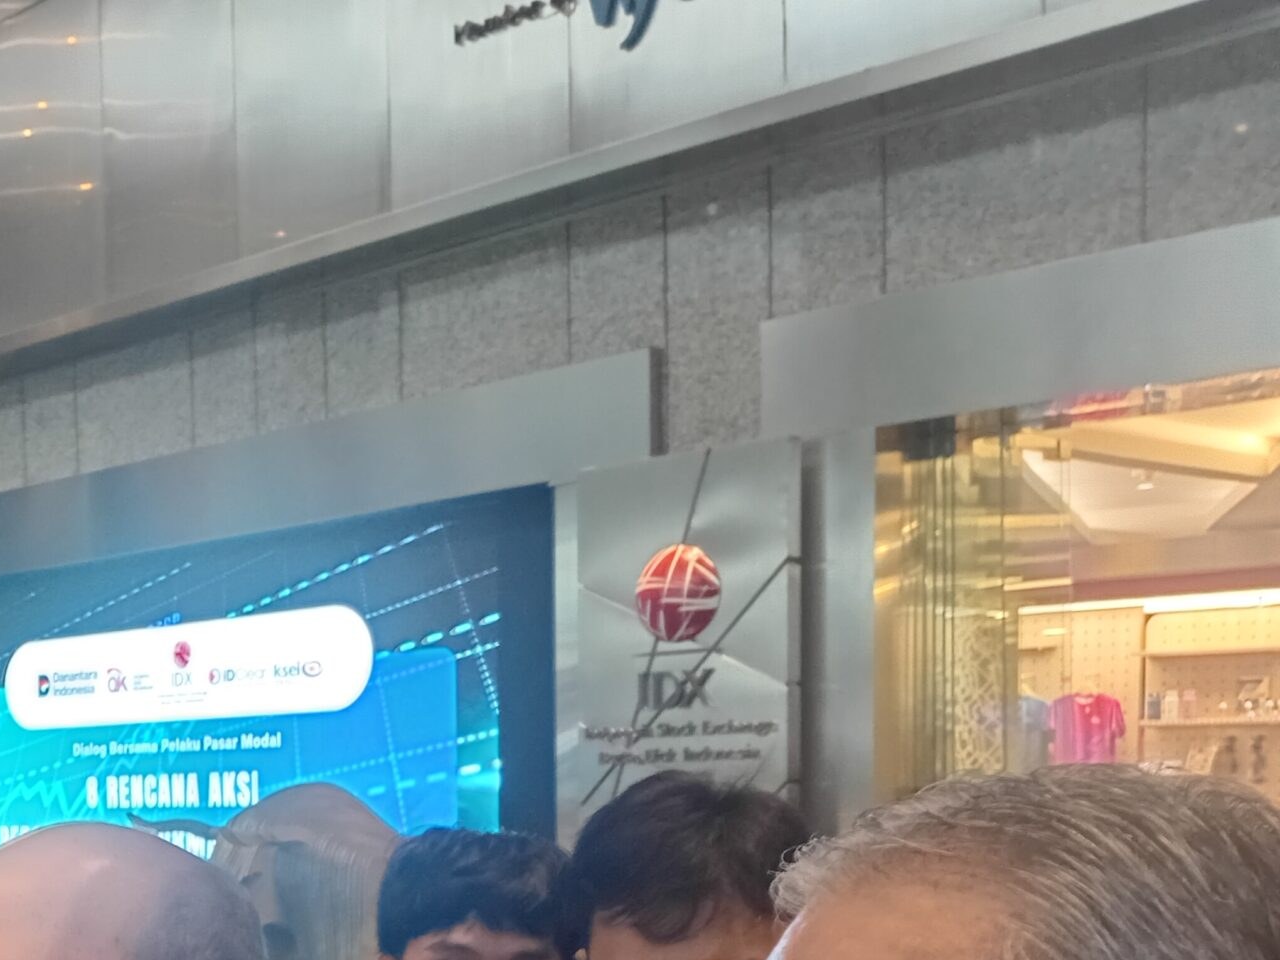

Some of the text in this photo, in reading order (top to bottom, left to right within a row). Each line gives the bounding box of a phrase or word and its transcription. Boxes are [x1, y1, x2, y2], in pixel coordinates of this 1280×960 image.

[53, 671, 98, 683] Danantara
[171, 671, 192, 687] IDX
[53, 685, 96, 697] Indonesia
[637, 668, 716, 709] IDX
[72, 731, 282, 759] Dialog Bersama Pelaku Pasar Modal
[106, 772, 200, 809] RENCANA
[207, 769, 260, 808] AKSI
